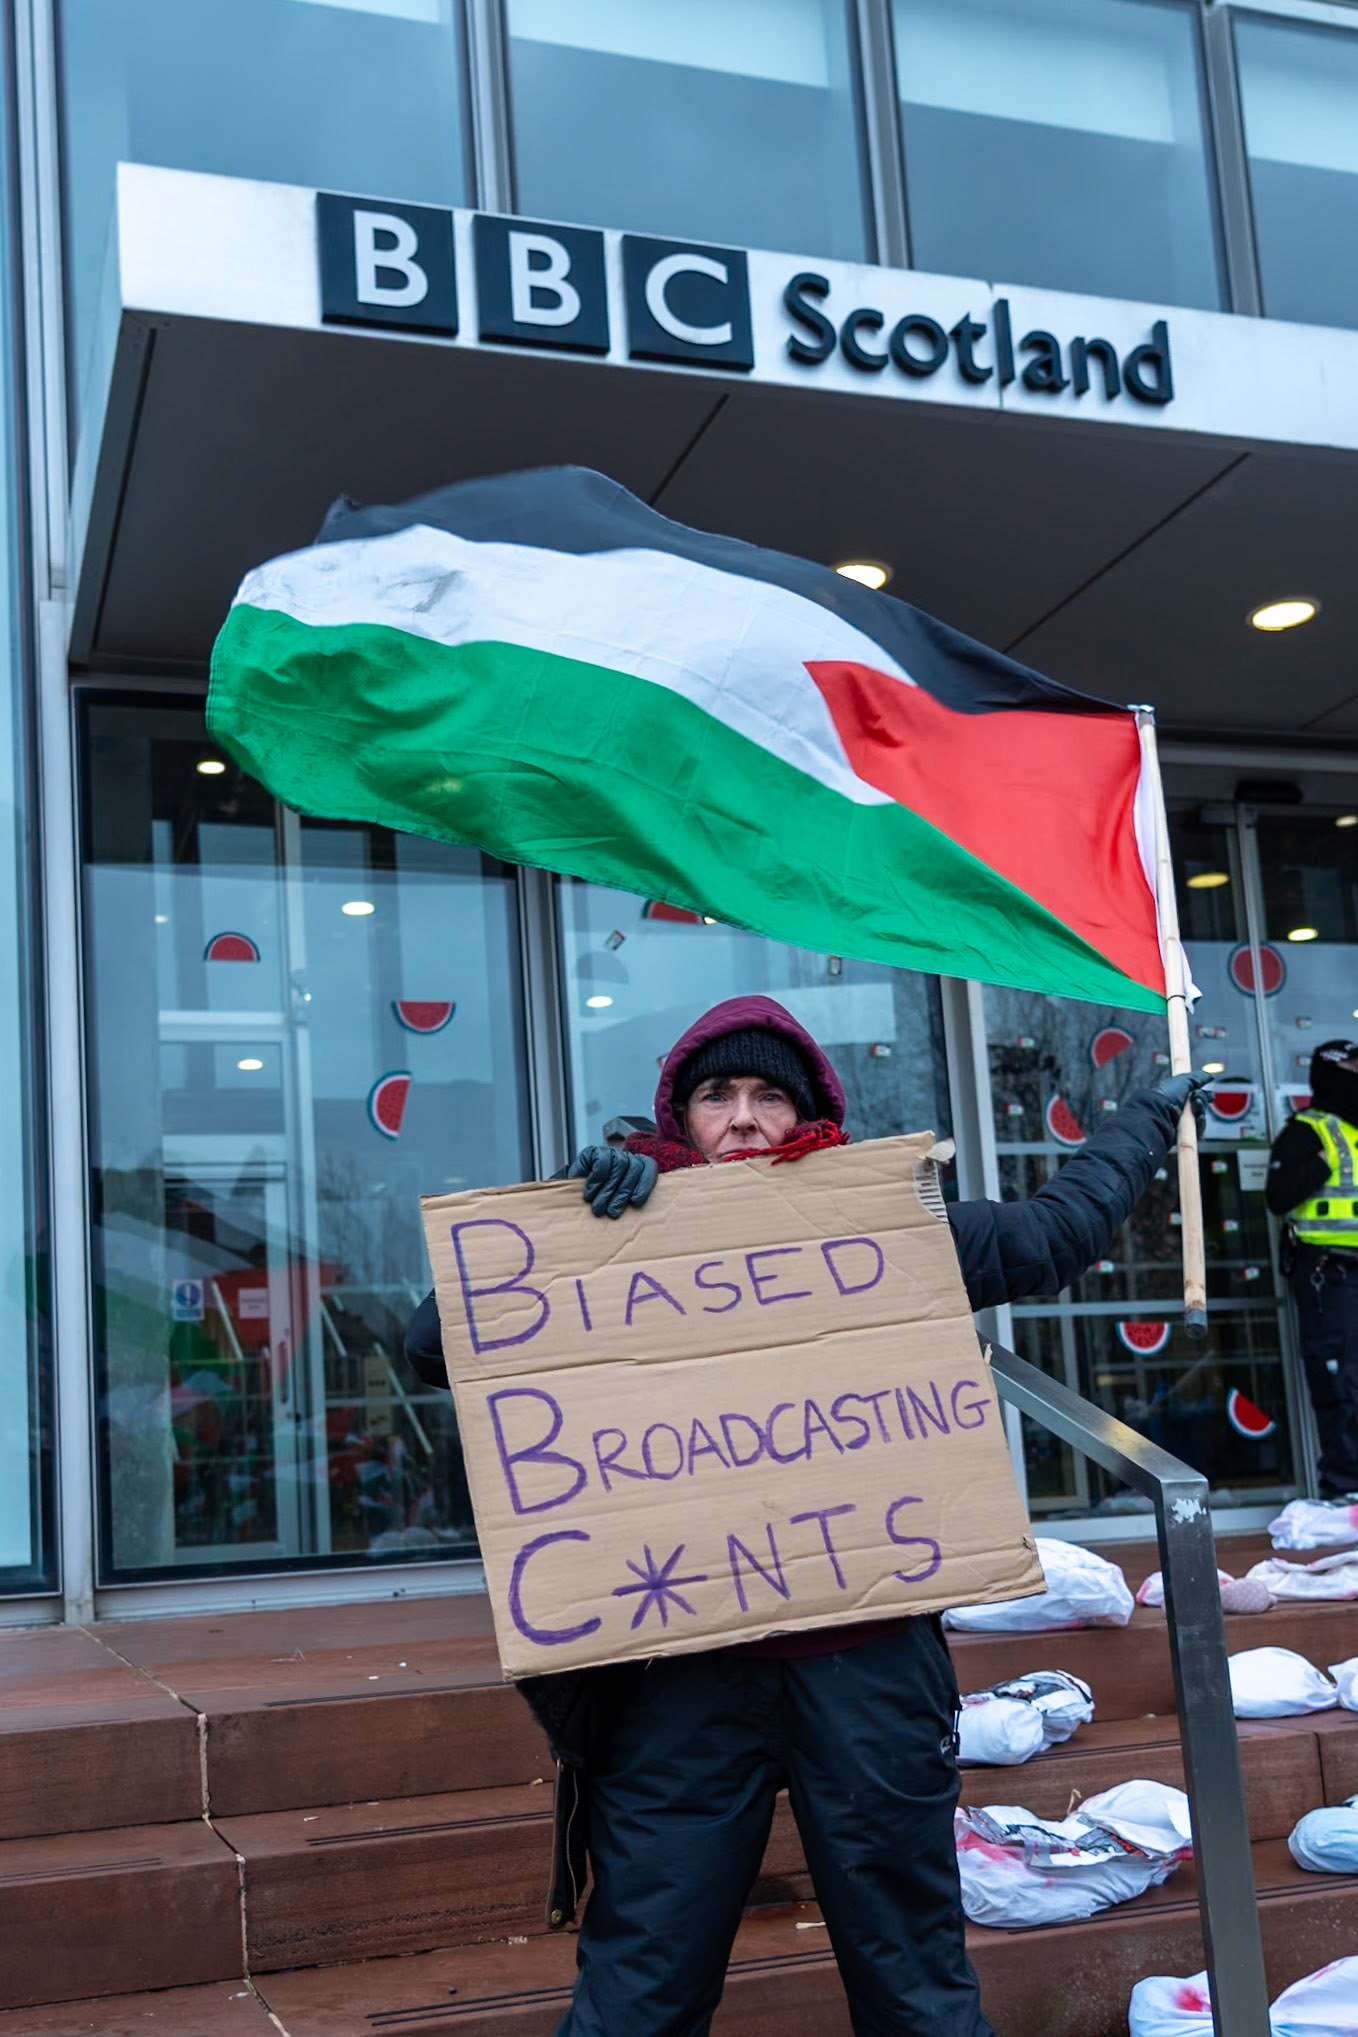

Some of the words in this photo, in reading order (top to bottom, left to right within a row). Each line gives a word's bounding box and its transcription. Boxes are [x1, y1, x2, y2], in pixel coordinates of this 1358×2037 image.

[352, 209, 733, 346] BBC
[783, 272, 1175, 406] Scotland
[450, 1218, 886, 1355] BIASED
[486, 1379, 991, 1516] BROADCASTING
